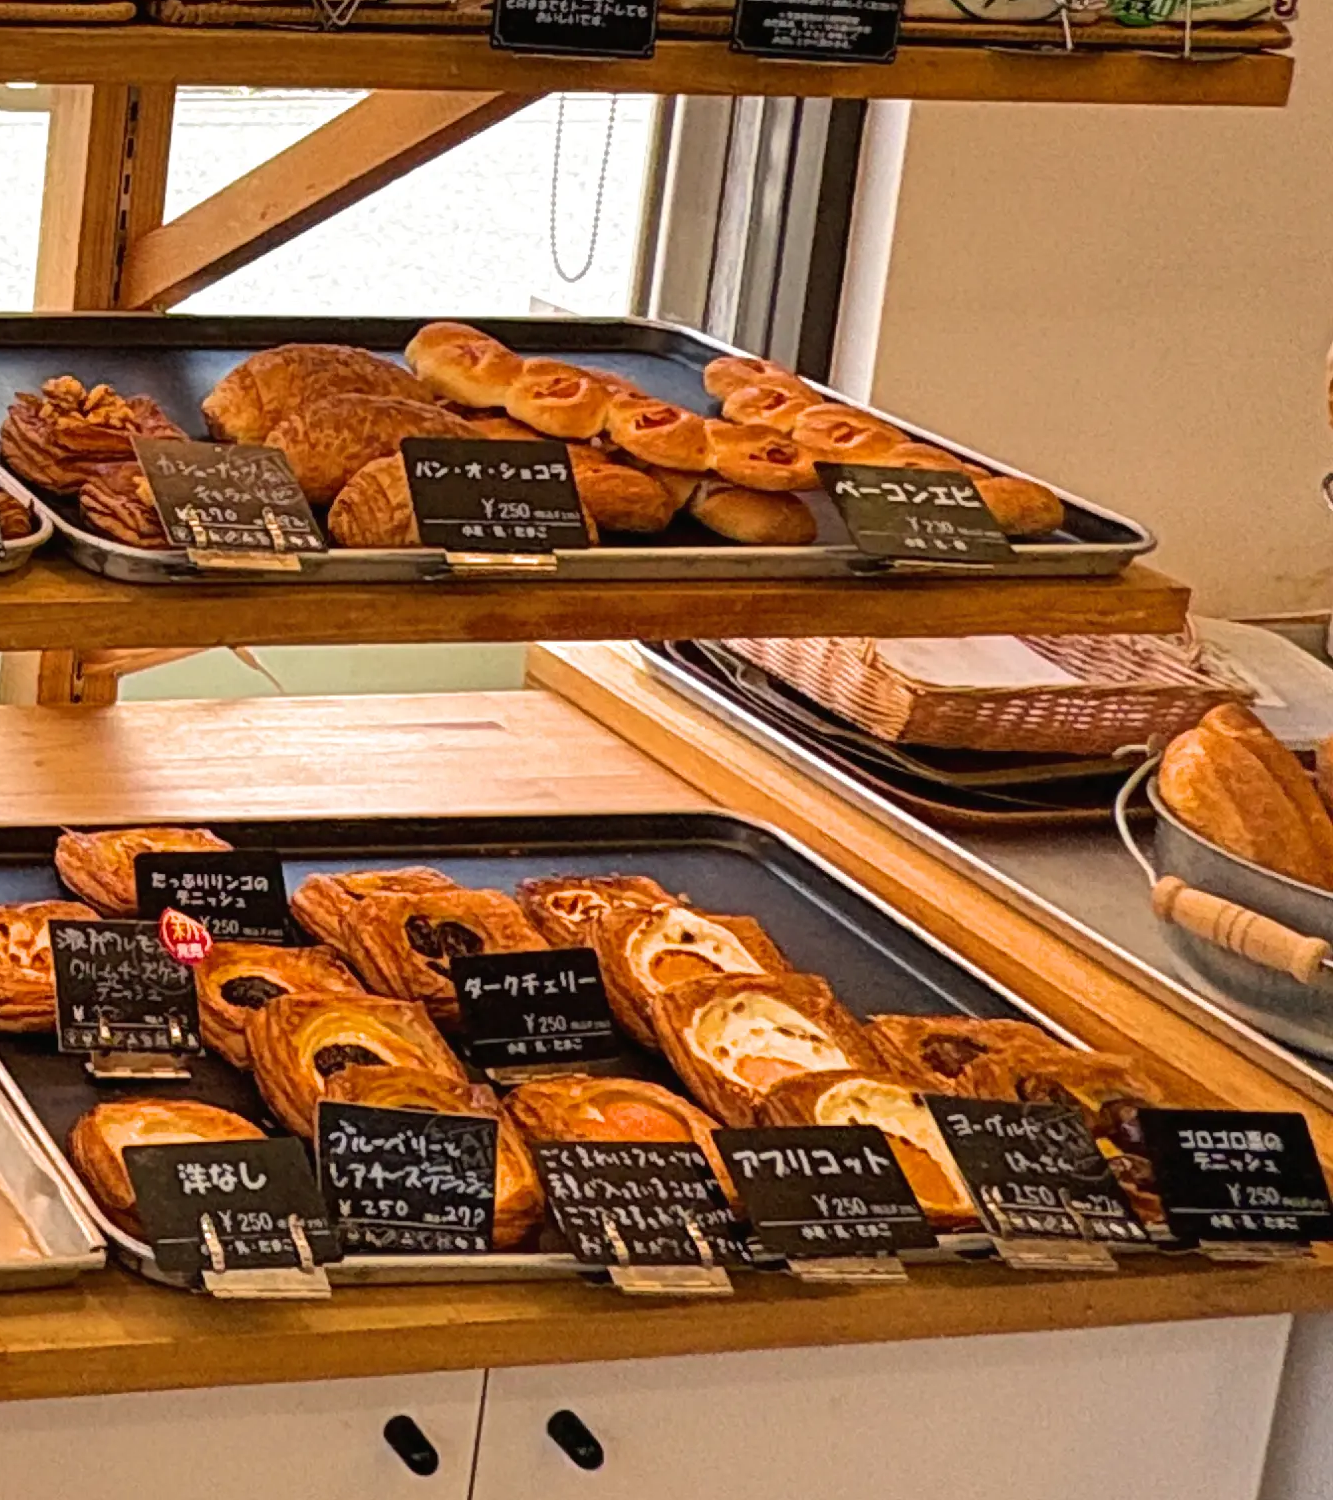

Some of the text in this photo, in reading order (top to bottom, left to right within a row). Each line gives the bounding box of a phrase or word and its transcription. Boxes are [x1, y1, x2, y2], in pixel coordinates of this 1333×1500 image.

[415, 460, 568, 482] パン・オ・ショコラ
[481, 498, 532, 519] ¥250
[151, 872, 269, 892] たっぷりリンゴの
[464, 970, 597, 999] ダークチェリー
[523, 1012, 567, 1035] ¥250
[732, 1145, 891, 1178] アプリコット
[177, 1161, 268, 1195] 洋なし
[812, 1193, 868, 1217] ¥250
[217, 1209, 274, 1234] ¥250
